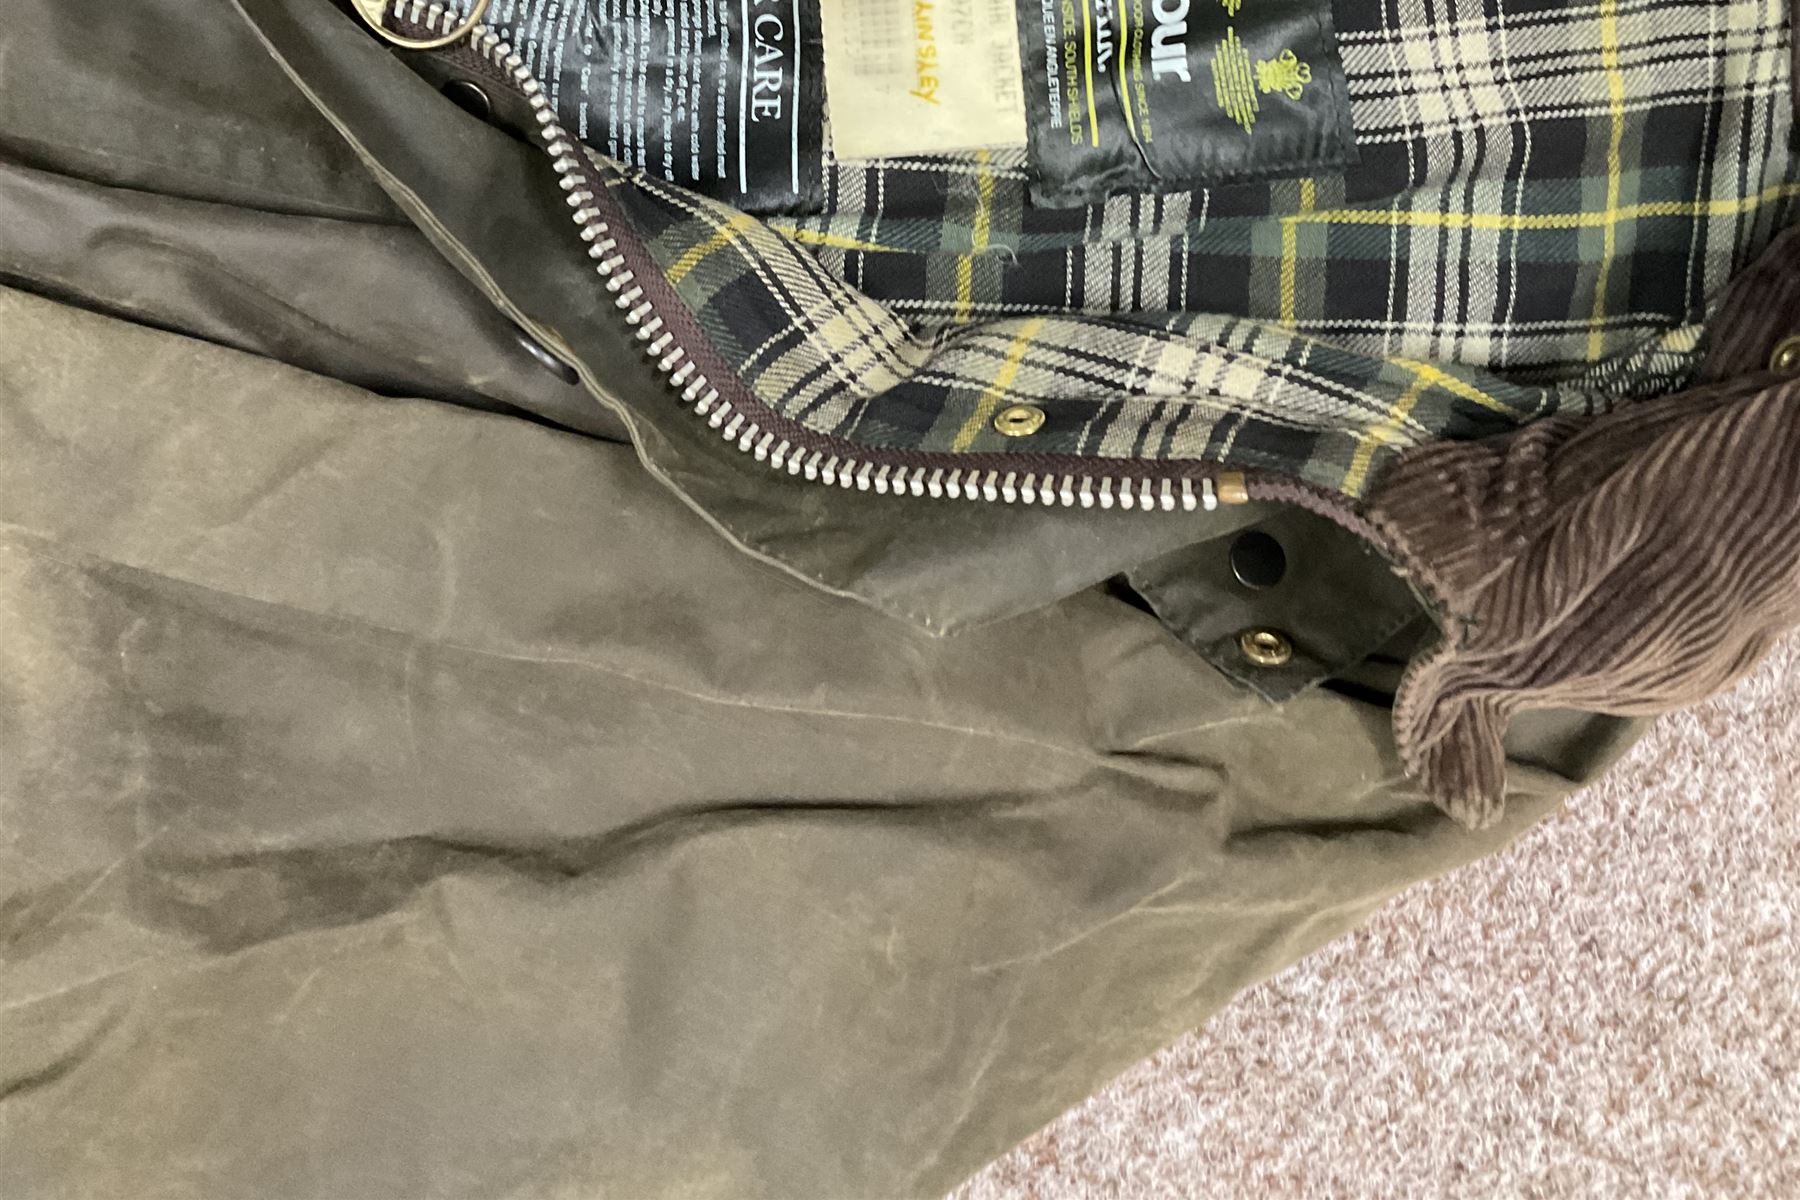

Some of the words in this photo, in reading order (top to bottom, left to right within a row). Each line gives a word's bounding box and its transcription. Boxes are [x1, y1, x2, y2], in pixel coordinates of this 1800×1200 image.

[1043, 24, 1058, 44] EN
[1131, 29, 1145, 81] CLOTHING
[751, 13, 784, 122] CARE
[1046, 45, 1063, 129] ANGLETERRE
[1064, 41, 1080, 87] SOUTH
[1066, 88, 1083, 146] SHIELDS
[1134, 83, 1150, 116] SINCE
